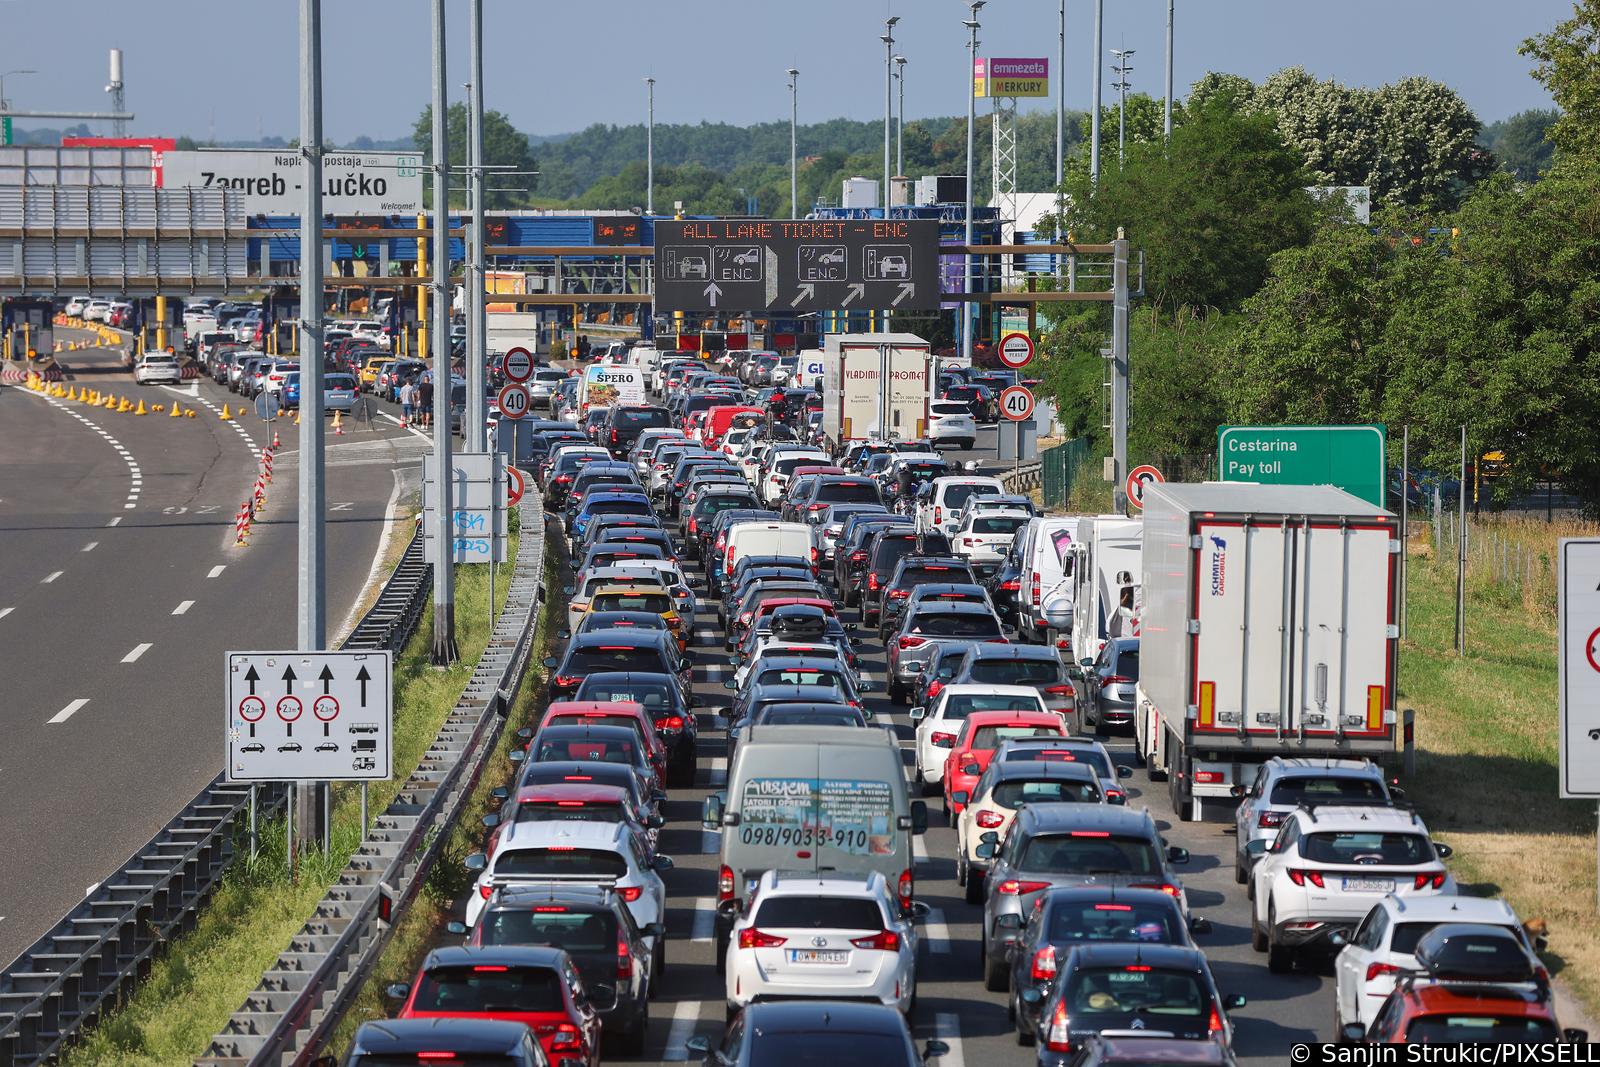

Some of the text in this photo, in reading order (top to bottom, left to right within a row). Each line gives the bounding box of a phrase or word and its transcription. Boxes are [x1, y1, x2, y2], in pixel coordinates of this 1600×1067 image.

[993, 62, 1045, 74] emmezeta
[996, 81, 1042, 92] MERKURY
[324, 156, 362, 168] postaja
[380, 202, 416, 210] Welcome!
[683, 223, 718, 238] ALL
[725, 223, 772, 238] LANE
[780, 223, 846, 238] TICKET
[873, 223, 908, 238] ENC
[722, 268, 753, 280] ENC
[807, 267, 839, 280] ENC
[807, 363, 824, 374] GL
[597, 371, 634, 383] ŠPERO
[846, 370, 881, 380] VLADIMI
[506, 393, 524, 410] 40
[1007, 395, 1027, 411] 40
[1228, 438, 1298, 452] Cestarina
[1229, 461, 1281, 477] Pay toll
[1212, 552, 1220, 596] SCHMITZ
[743, 827, 867, 848] 098/9033-910
